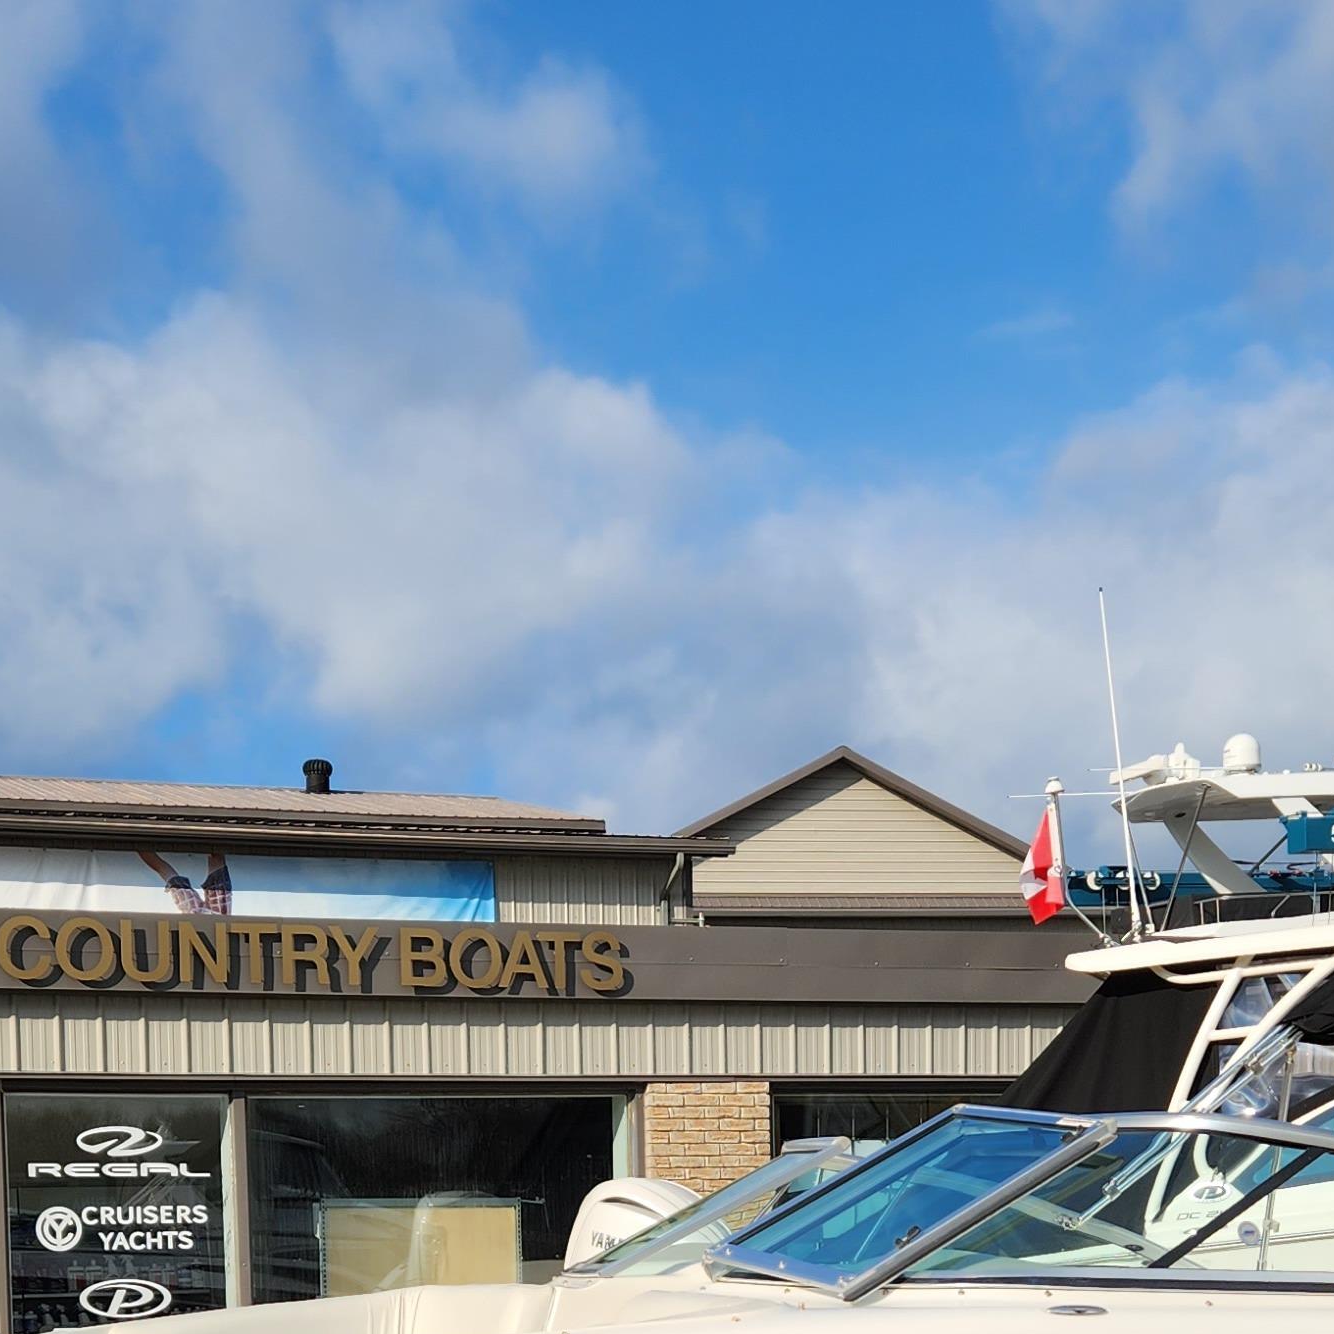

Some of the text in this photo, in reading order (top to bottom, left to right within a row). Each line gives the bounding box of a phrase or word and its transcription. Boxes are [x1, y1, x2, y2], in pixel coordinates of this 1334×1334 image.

[400, 927, 624, 991] BOATS
[27, 1162, 211, 1178] REGAL
[81, 1204, 209, 1225] CRUISERS
[98, 1230, 194, 1251] YACHTS
